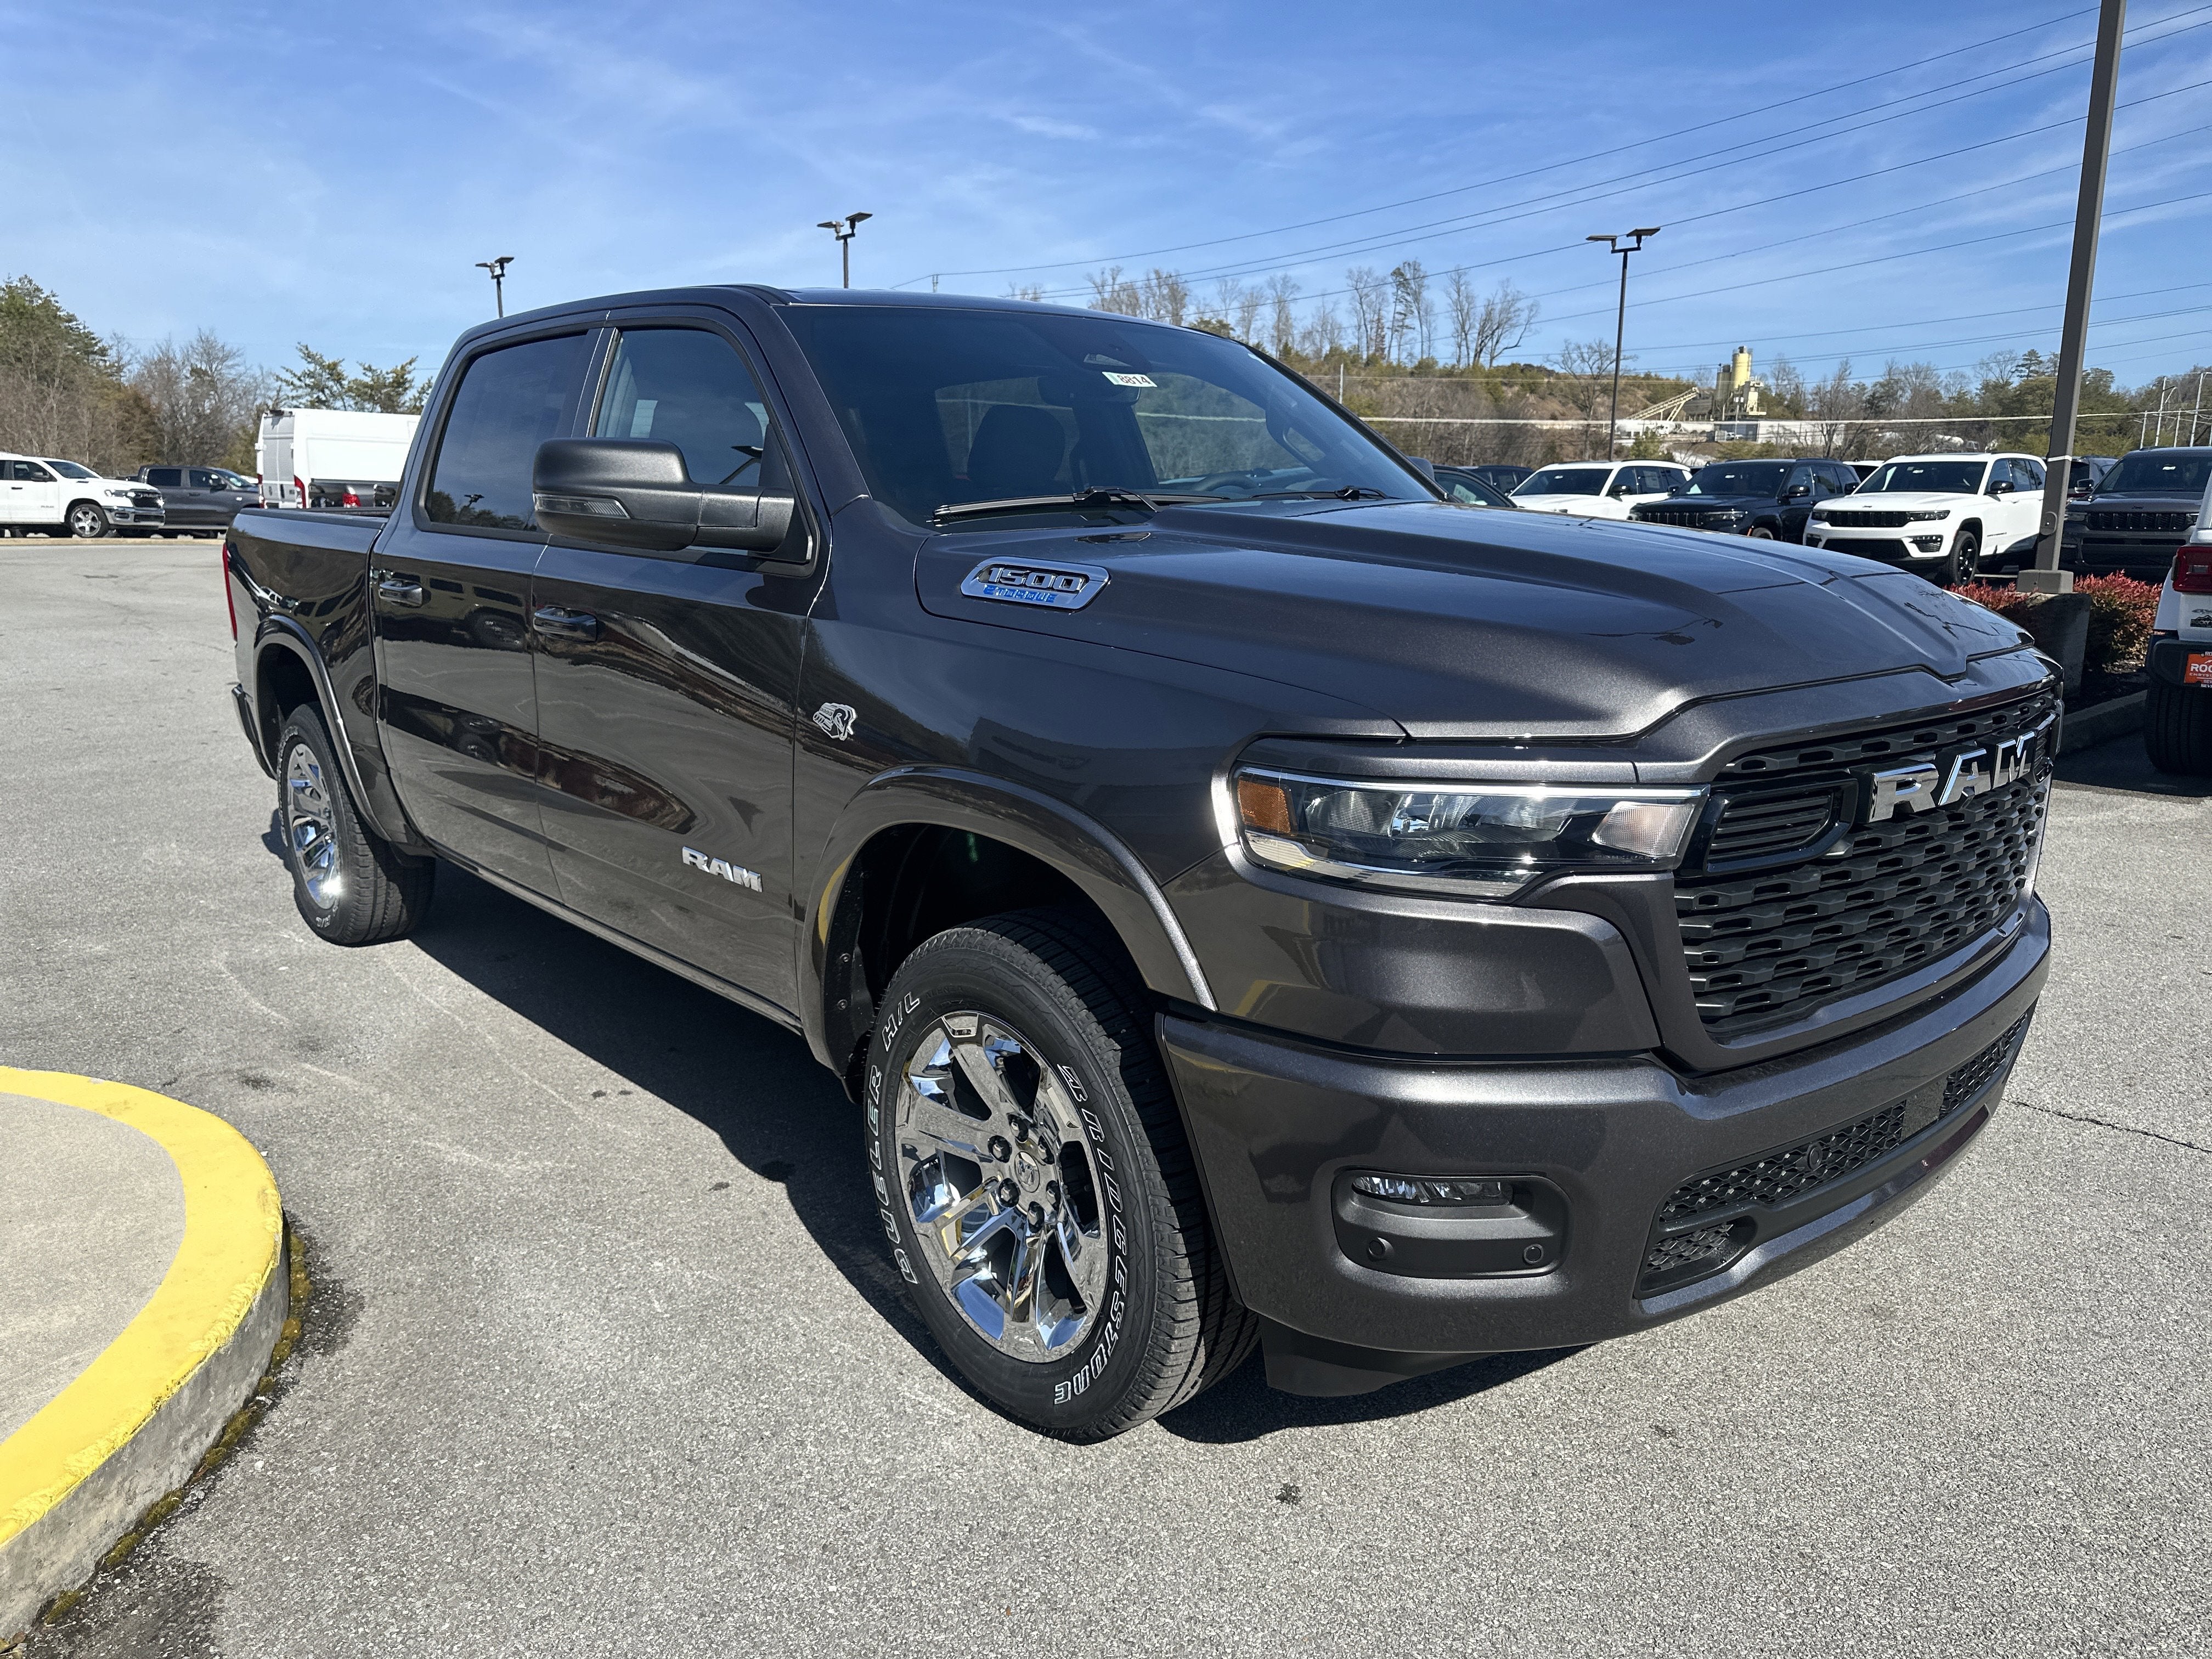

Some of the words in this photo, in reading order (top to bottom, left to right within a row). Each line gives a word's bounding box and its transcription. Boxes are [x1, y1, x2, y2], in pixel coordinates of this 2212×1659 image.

[1116, 375, 1152, 385] 8814
[988, 567, 1086, 591] 1500
[1868, 731, 2035, 822] RAM
[682, 846, 763, 893] RAM
[867, 1064, 917, 1284] DUELER
[1054, 1064, 1128, 1406] BRIDGESTONE
